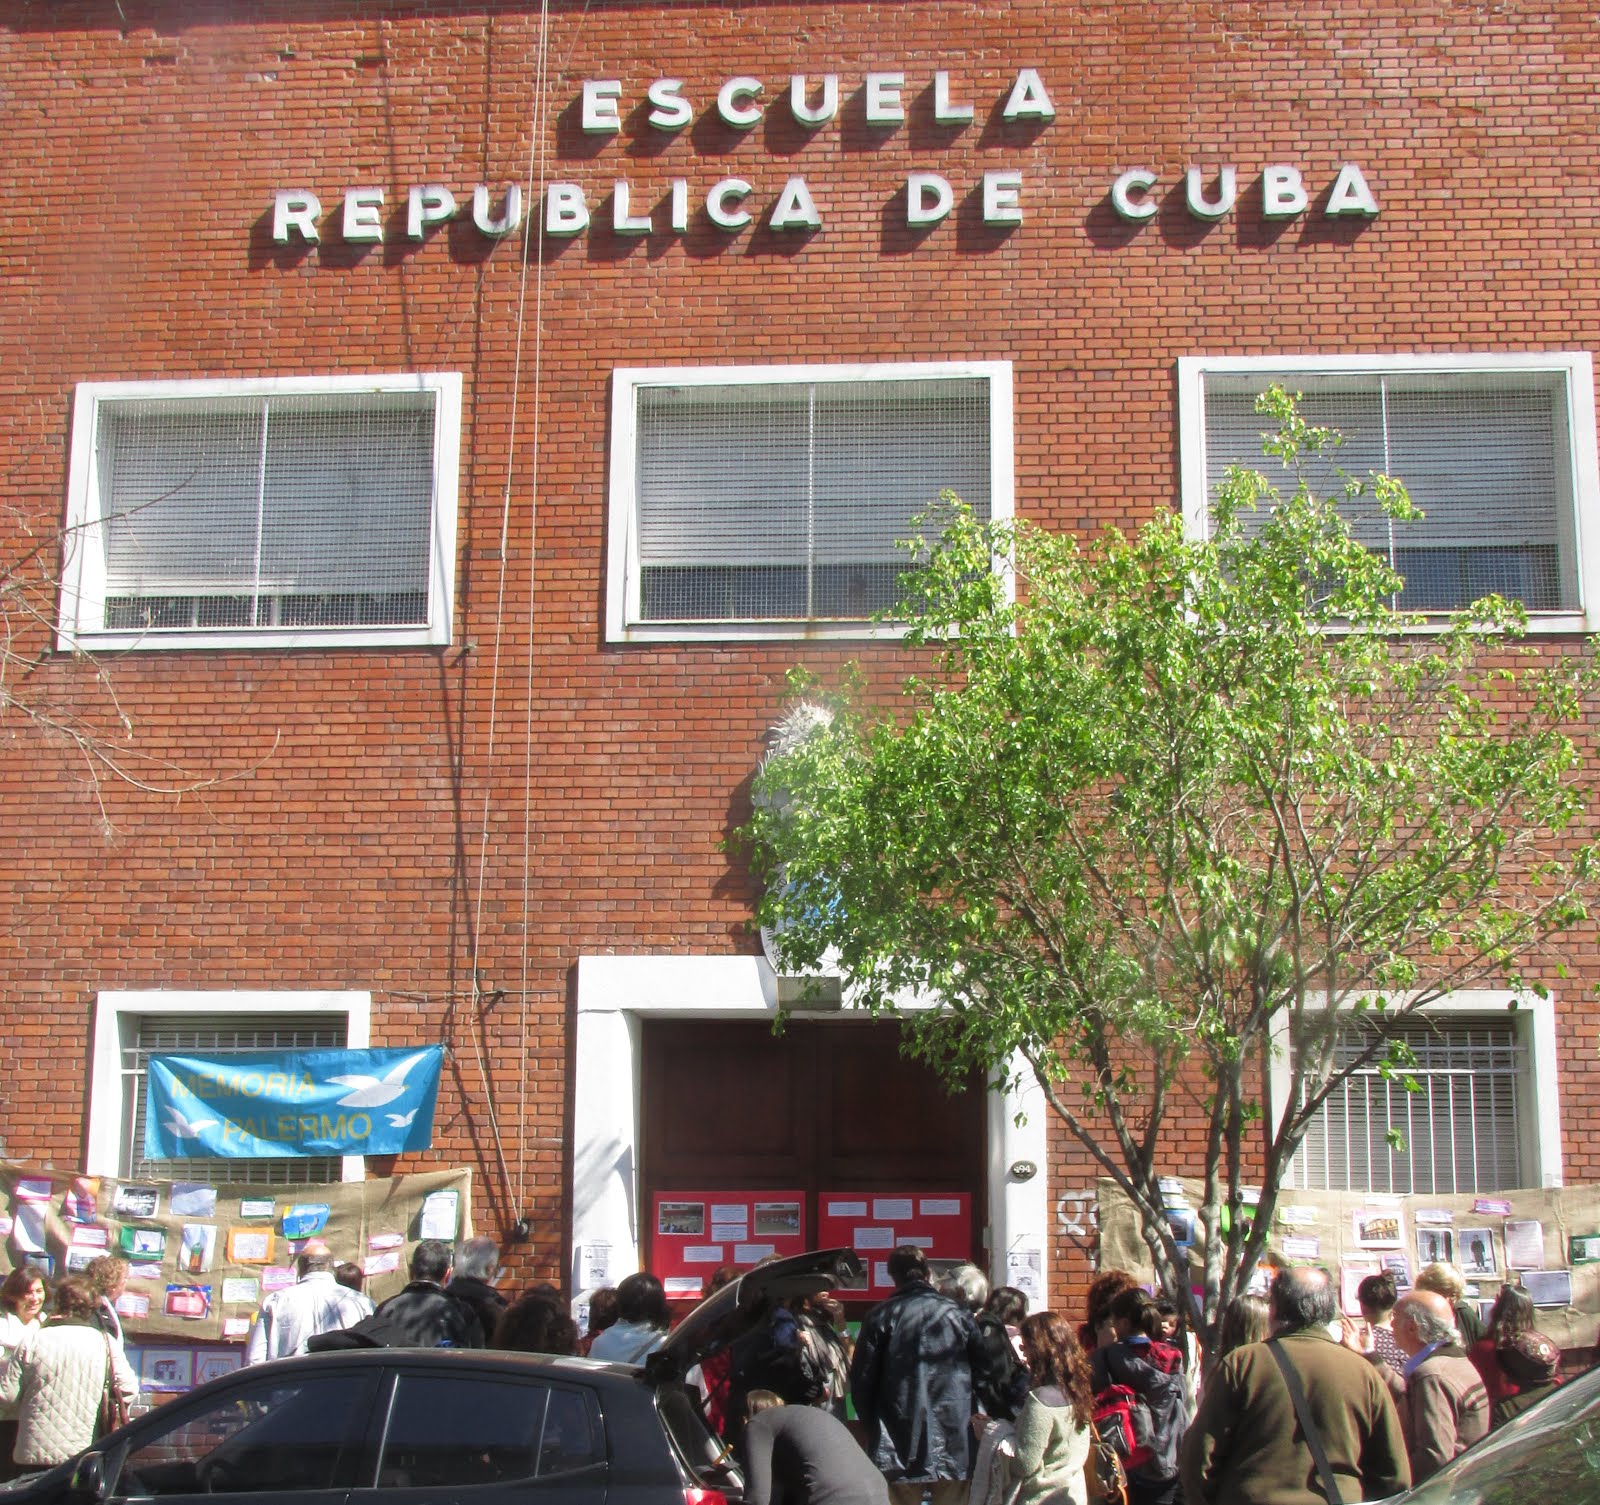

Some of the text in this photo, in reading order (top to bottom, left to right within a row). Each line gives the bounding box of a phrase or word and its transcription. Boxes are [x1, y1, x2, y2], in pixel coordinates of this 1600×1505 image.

[582, 68, 1056, 135] ESCUELA
[272, 164, 1381, 245] REPUBLICA DE CUBA
[171, 1072, 316, 1099] MEMORIA
[223, 1113, 372, 1141] PALERMO
